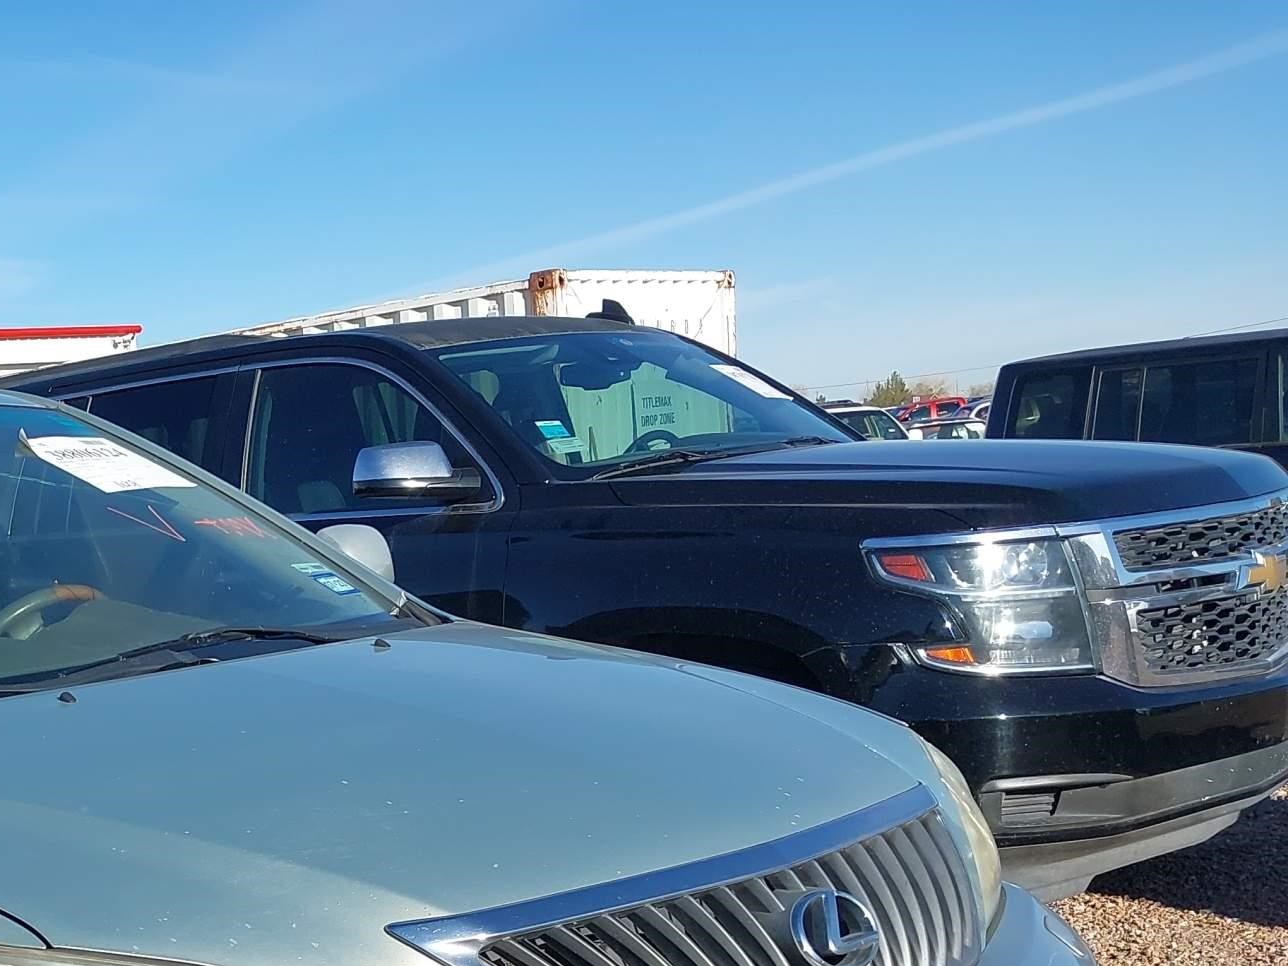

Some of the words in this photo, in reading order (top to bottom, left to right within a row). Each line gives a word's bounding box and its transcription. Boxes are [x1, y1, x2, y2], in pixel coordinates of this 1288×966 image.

[641, 396, 673, 409] TITLEMAX
[641, 414, 658, 427] DROP
[659, 412, 676, 425] ZONE
